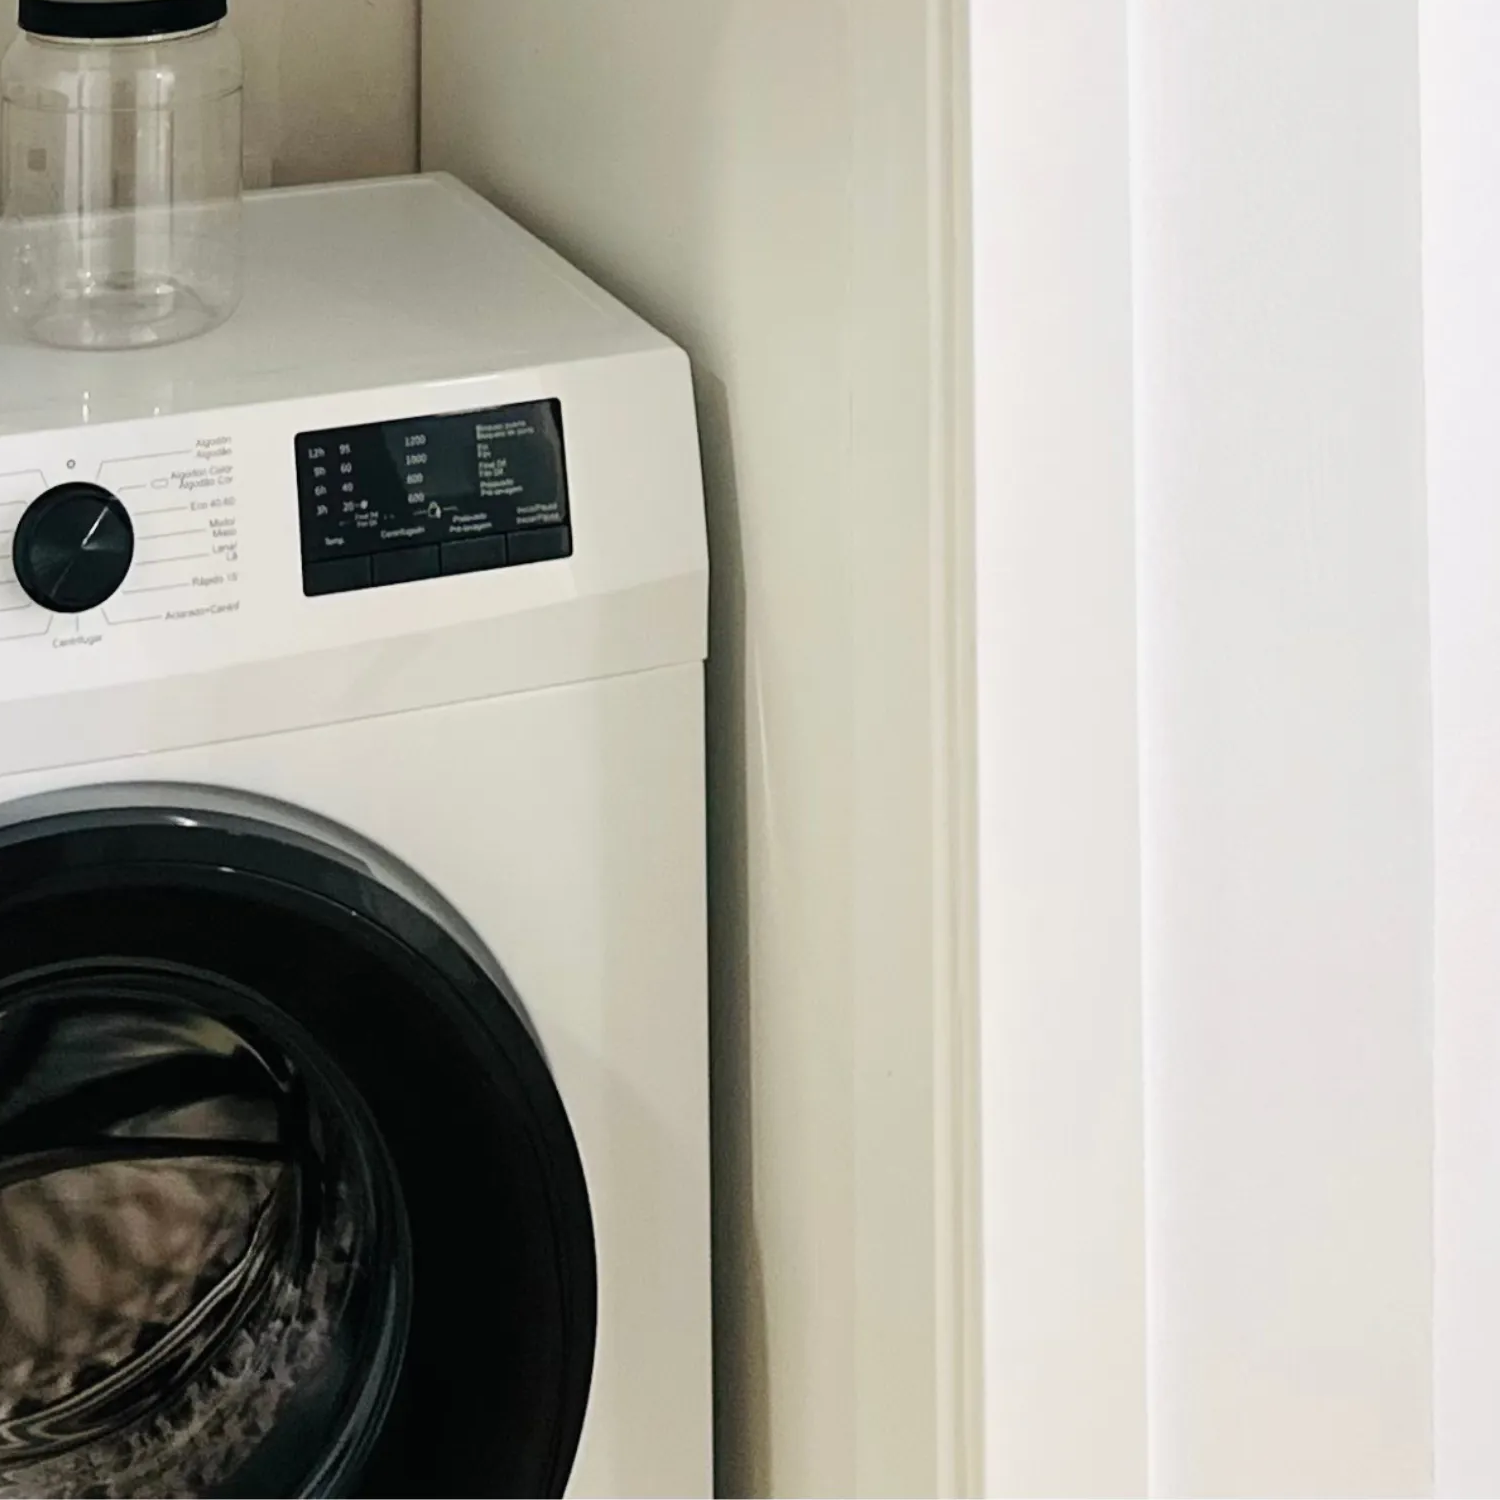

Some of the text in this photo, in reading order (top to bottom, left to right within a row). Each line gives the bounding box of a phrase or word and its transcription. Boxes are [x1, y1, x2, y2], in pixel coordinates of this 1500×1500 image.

[404, 434, 427, 448] 1200
[308, 447, 325, 459] 12h
[340, 461, 352, 474] 60
[406, 472, 424, 485] 800
[314, 485, 328, 497] 6h
[341, 481, 354, 493] 40
[407, 491, 426, 504] 600
